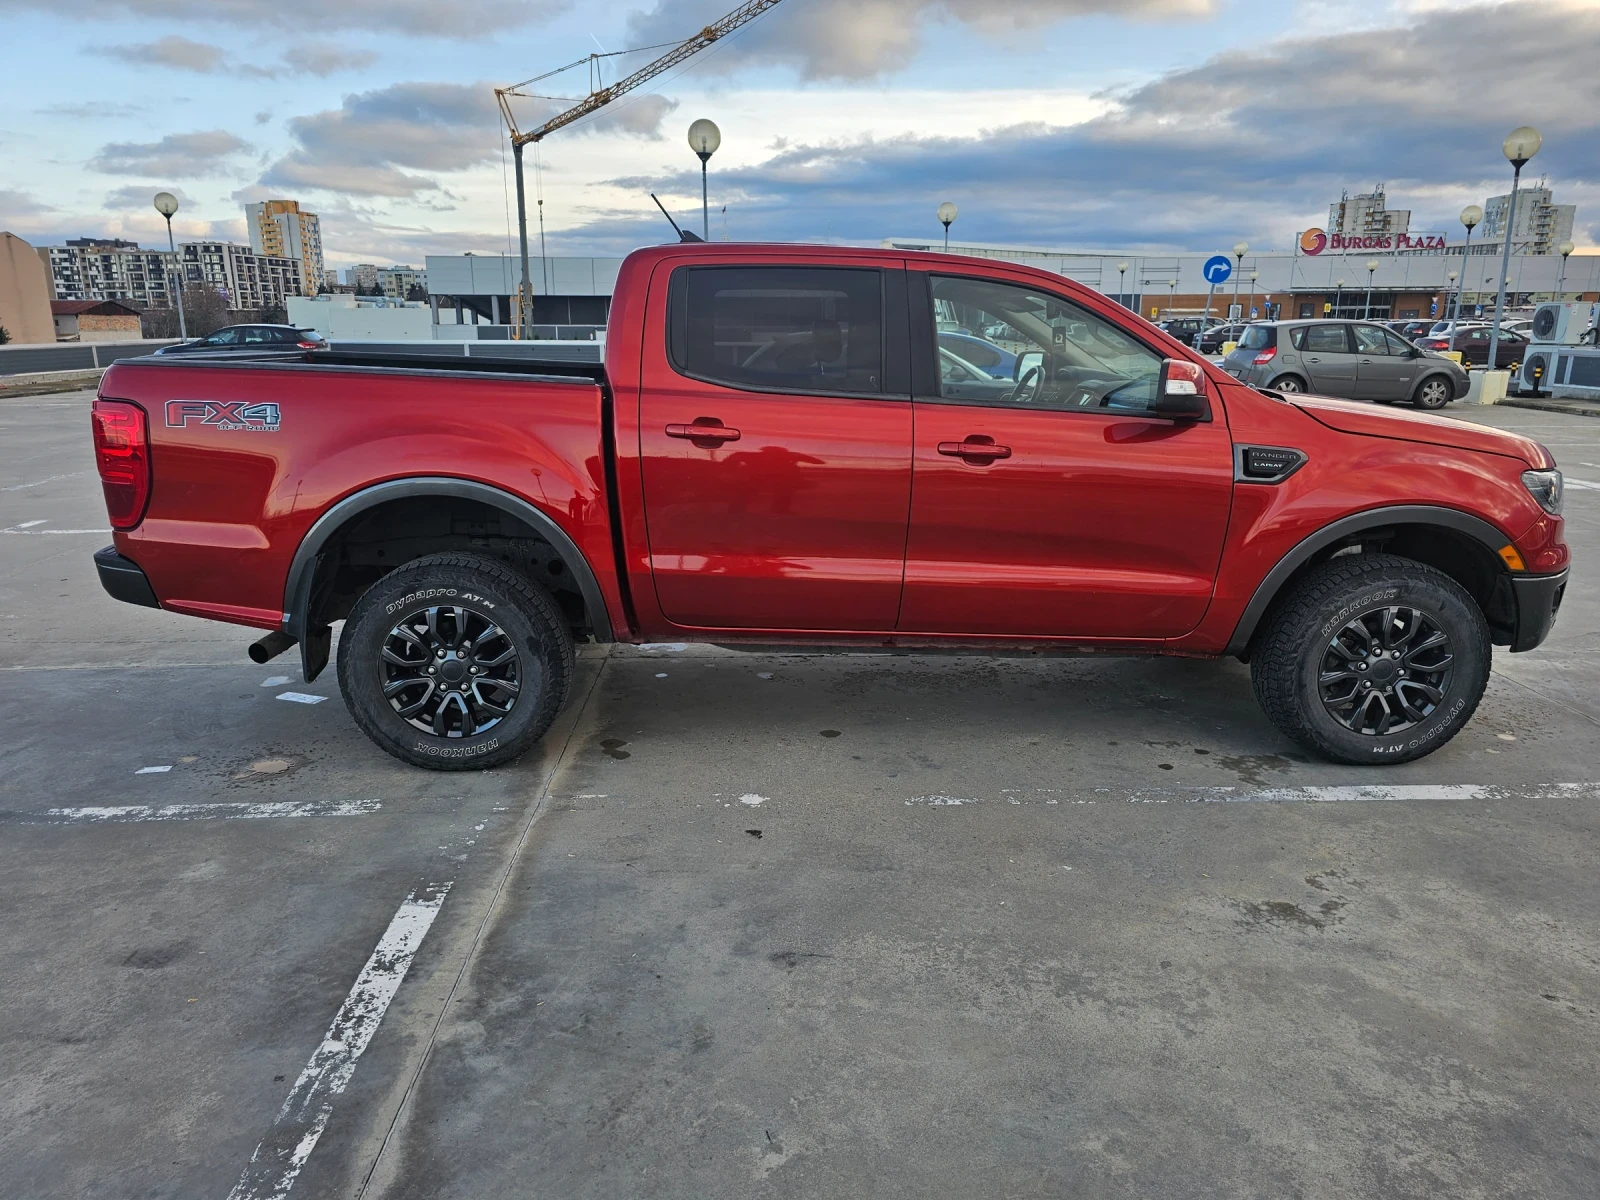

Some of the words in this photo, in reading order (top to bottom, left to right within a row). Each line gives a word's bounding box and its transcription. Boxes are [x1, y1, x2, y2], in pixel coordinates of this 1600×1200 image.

[1330, 233, 1391, 250] BURGAS
[1397, 234, 1445, 249] PLAZA
[165, 400, 281, 428] FX4
[1252, 452, 1296, 460] RANGER
